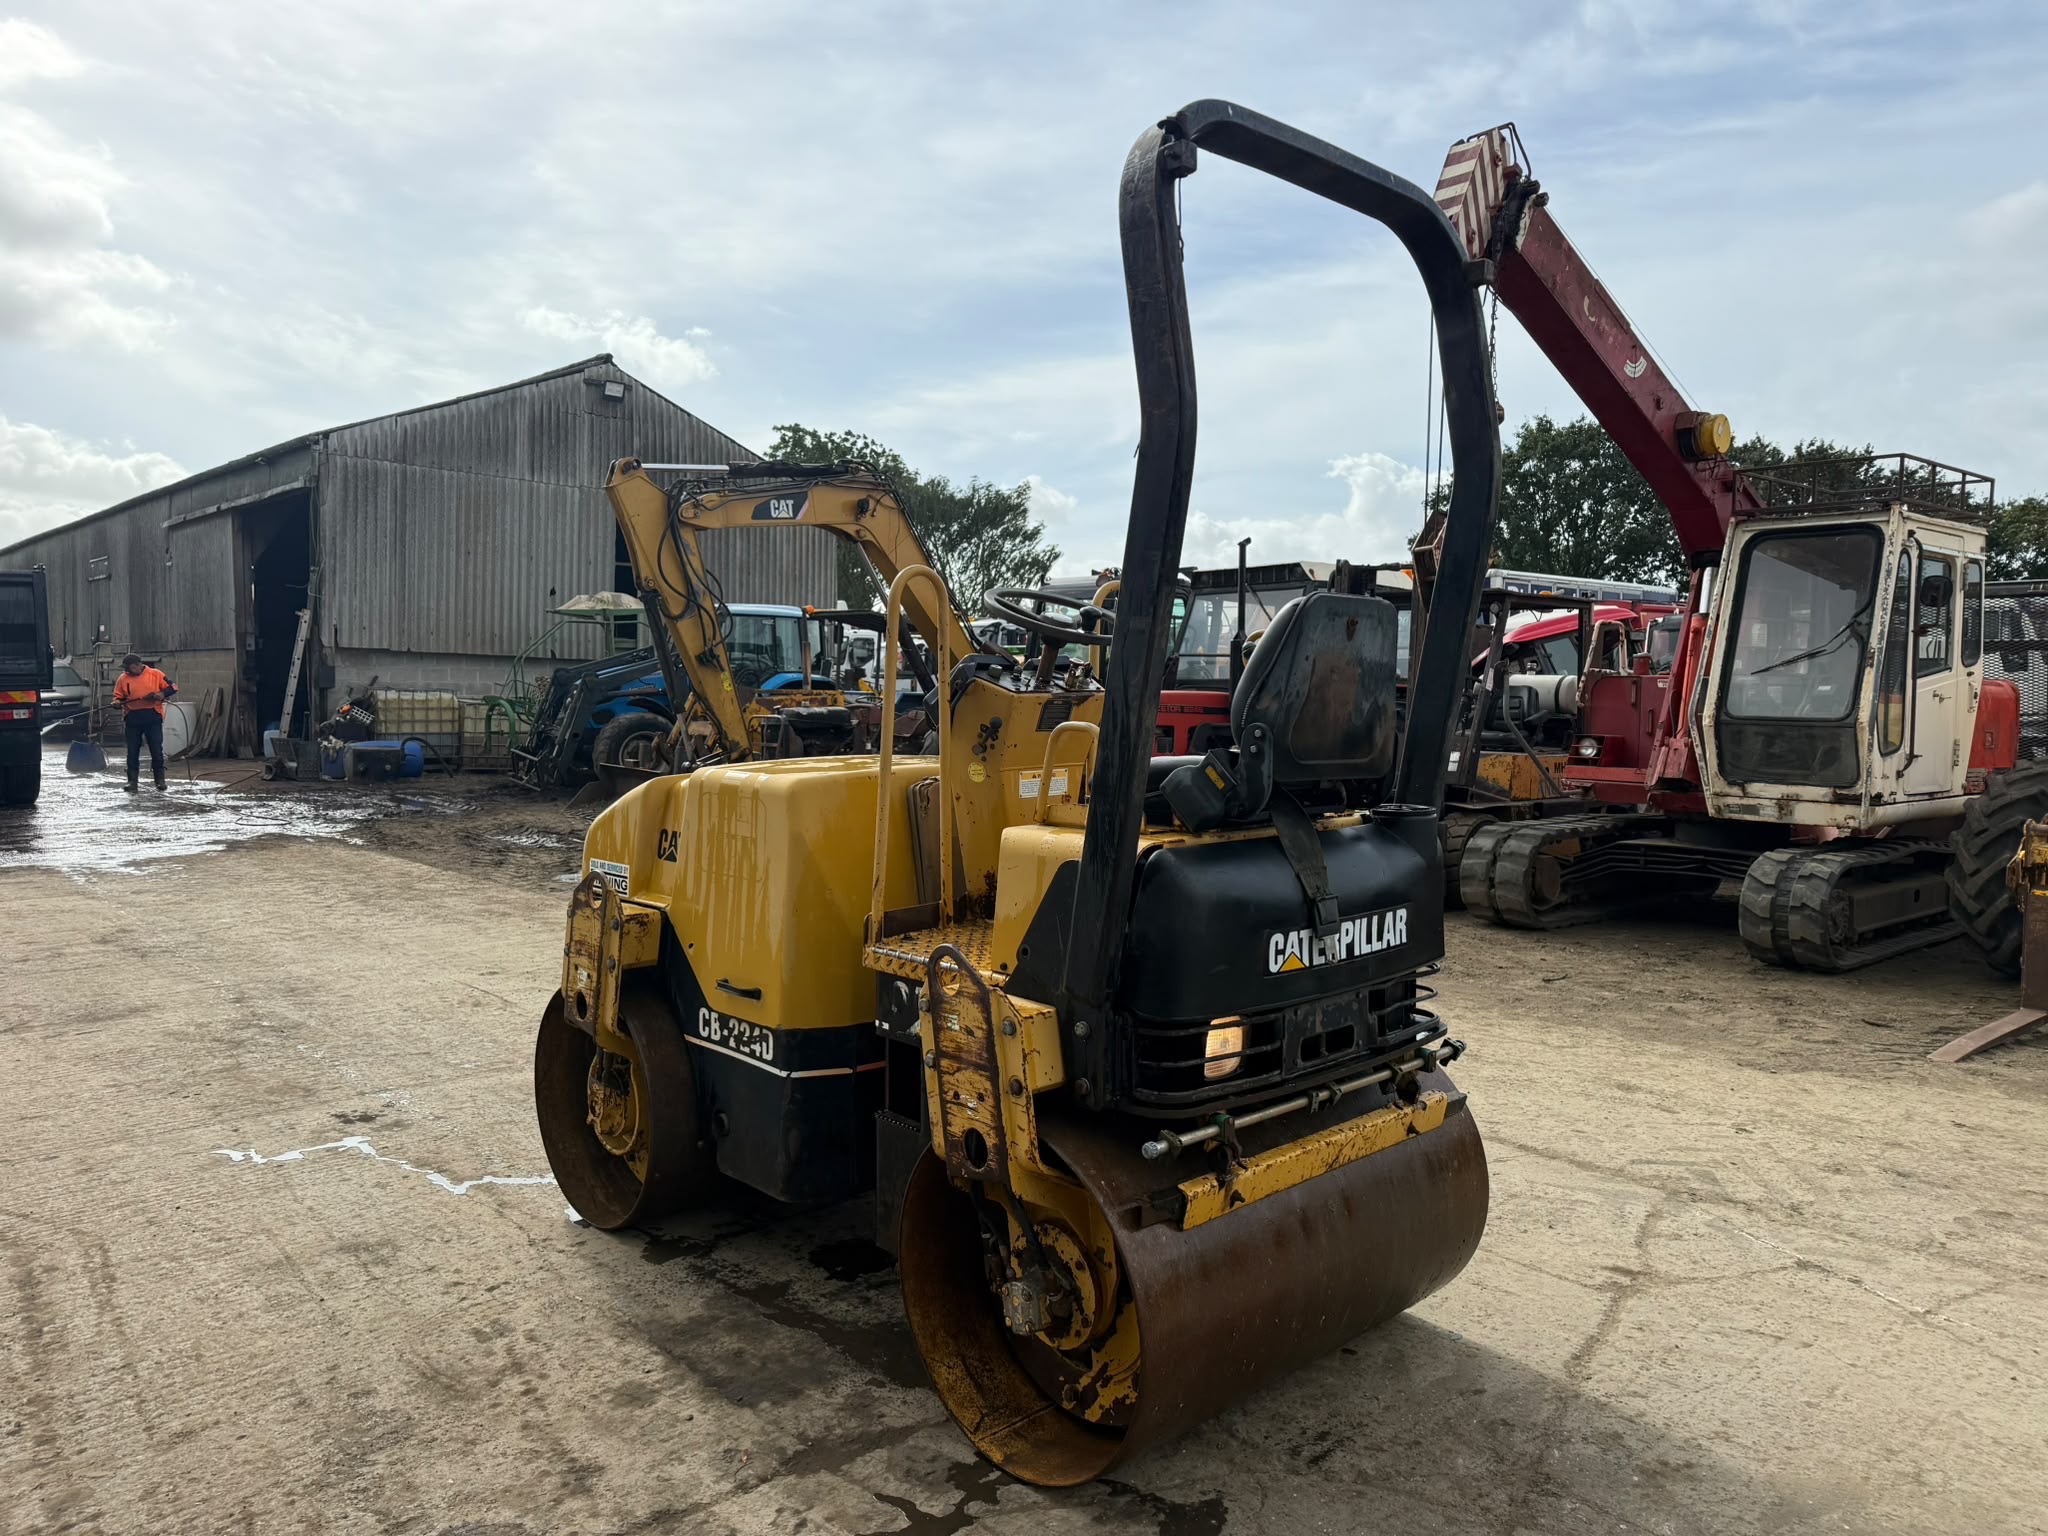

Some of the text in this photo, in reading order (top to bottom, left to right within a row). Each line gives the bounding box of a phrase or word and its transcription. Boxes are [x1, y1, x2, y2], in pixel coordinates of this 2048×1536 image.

[770, 499, 794, 518] CAT
[657, 828, 681, 863] CA
[698, 1007, 774, 1061] CB-224D
